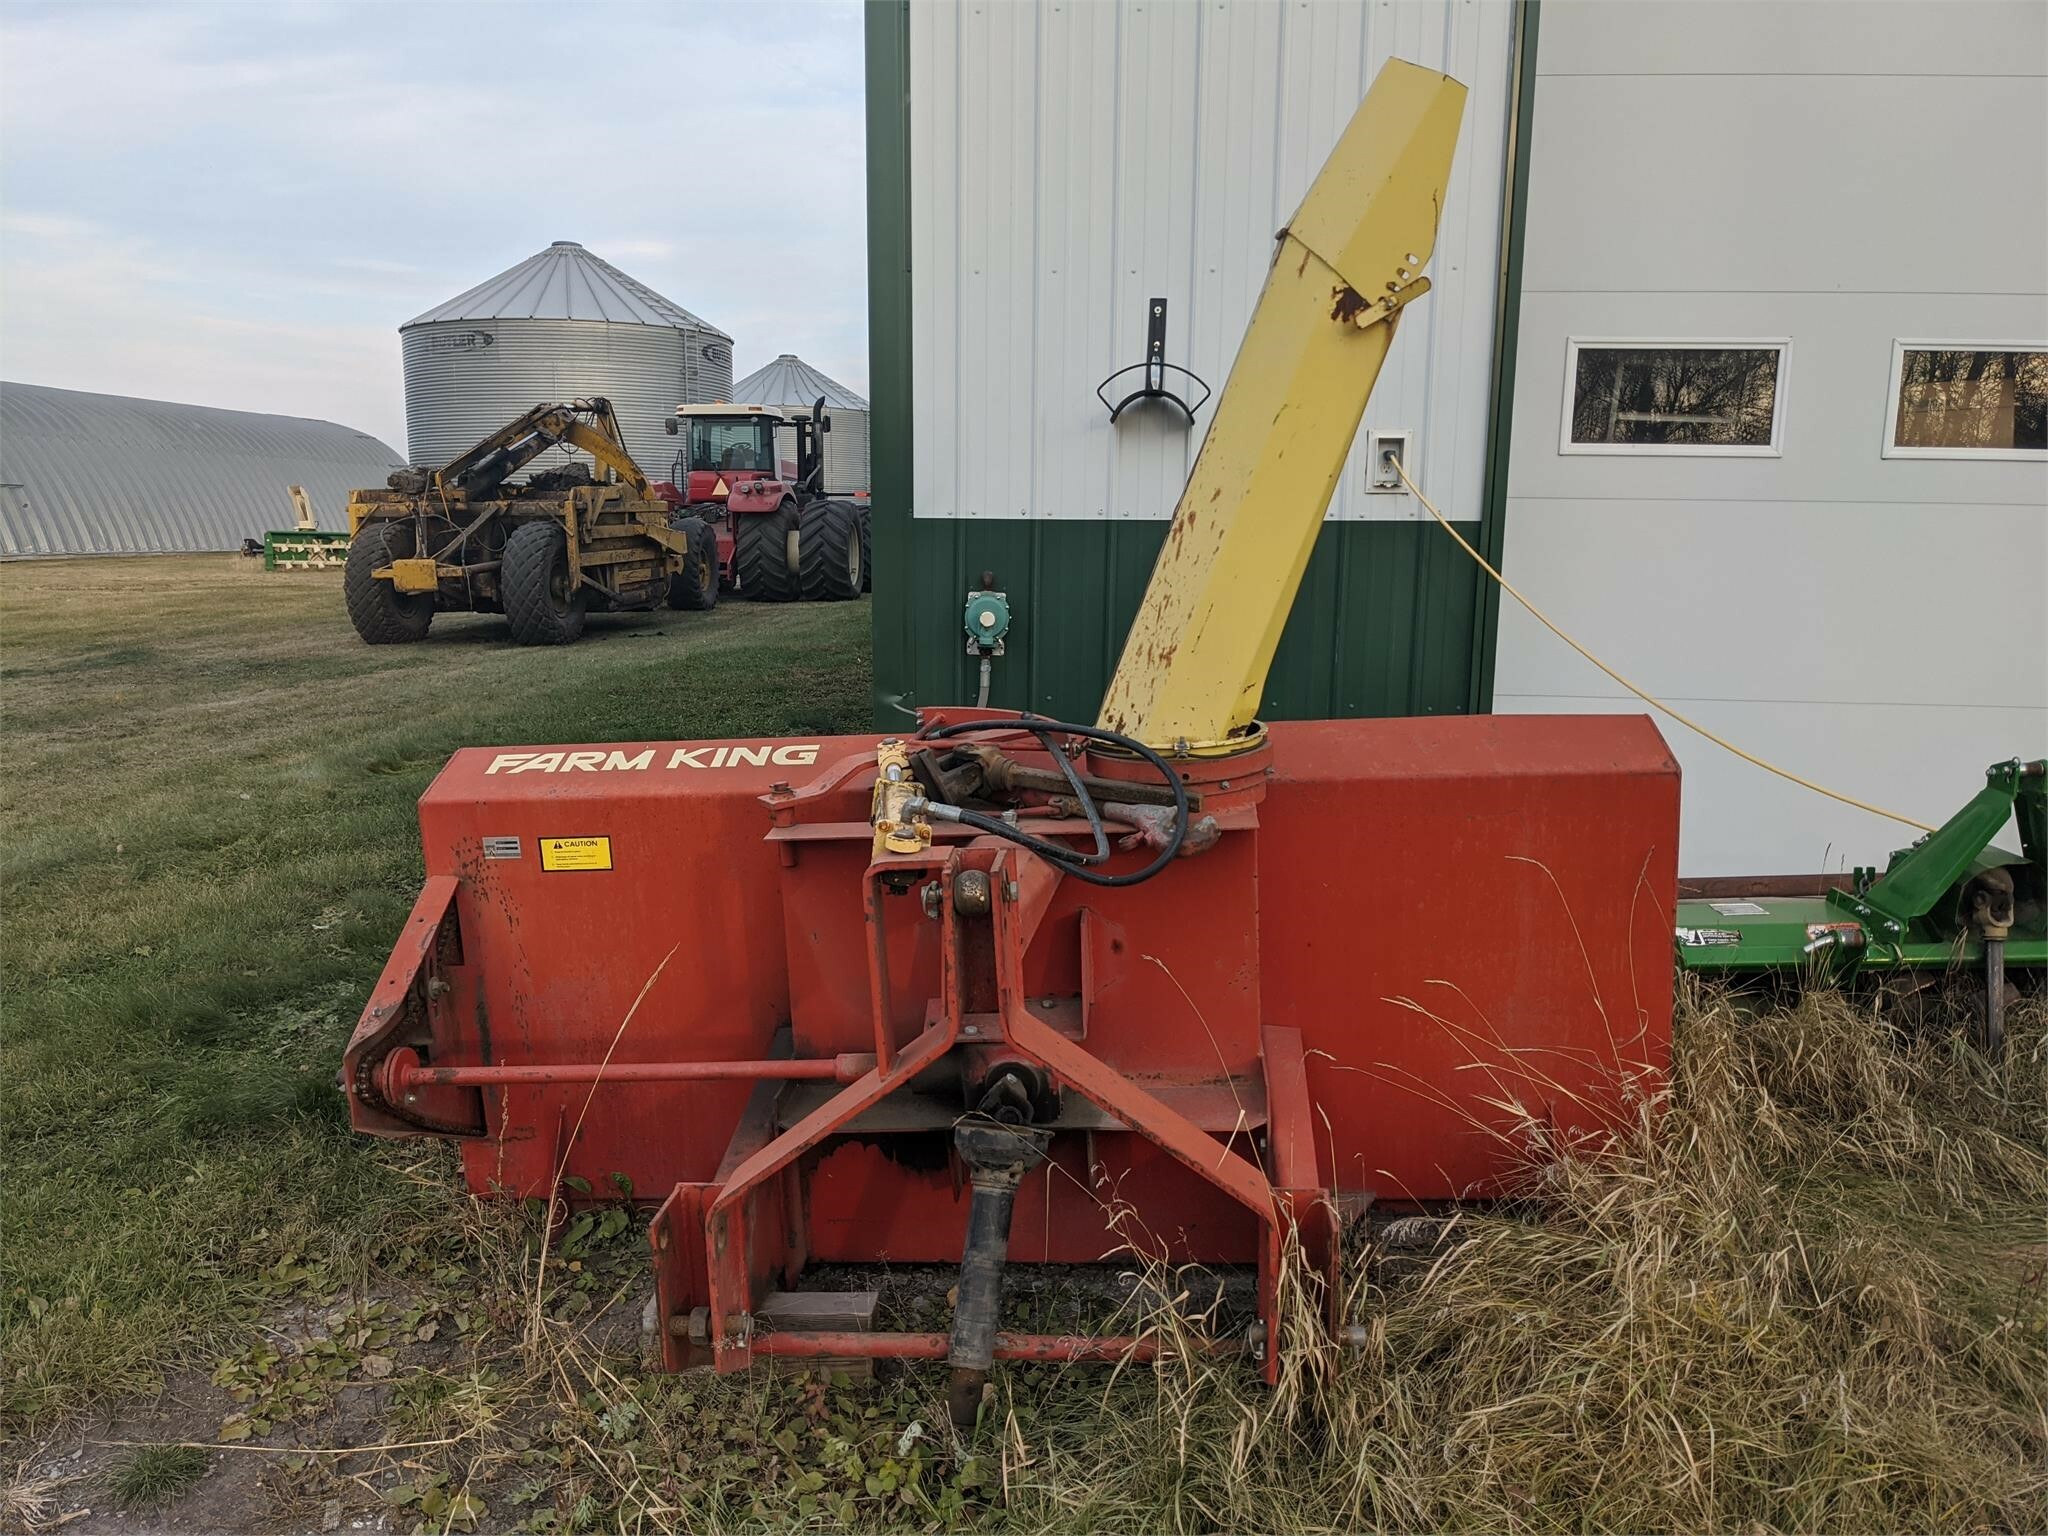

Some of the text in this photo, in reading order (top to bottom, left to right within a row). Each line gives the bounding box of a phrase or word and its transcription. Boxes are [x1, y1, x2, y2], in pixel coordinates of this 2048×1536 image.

[484, 744, 821, 775] FARM KING
[563, 840, 598, 848] CAUTION
